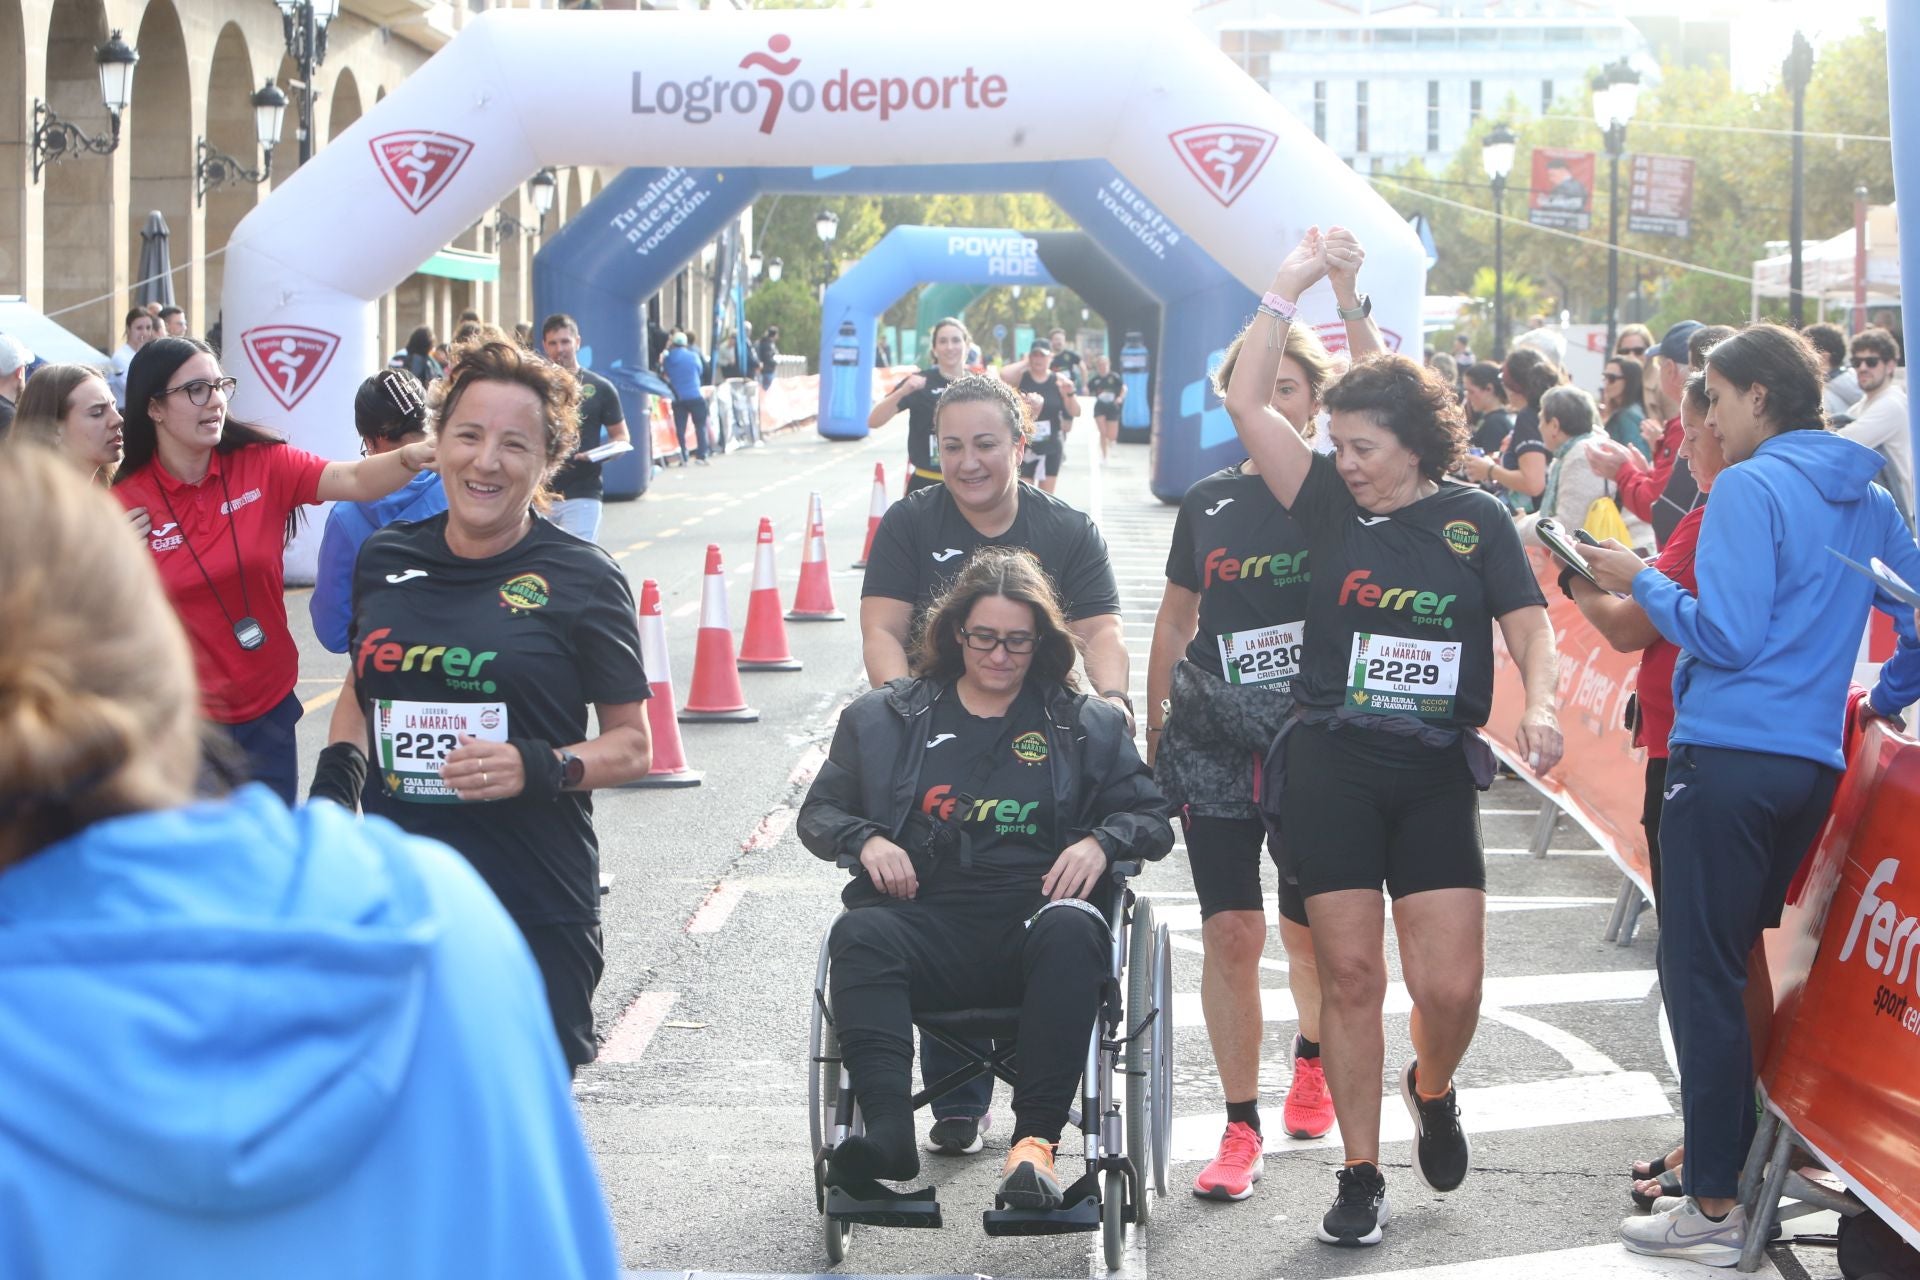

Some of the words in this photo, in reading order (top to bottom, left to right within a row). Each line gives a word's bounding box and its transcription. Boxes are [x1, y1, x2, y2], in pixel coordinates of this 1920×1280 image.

[821, 67, 1009, 121] deporte
[610, 207, 639, 232] Tu
[636, 165, 687, 211] salud,
[626, 176, 697, 244] nuestra
[1109, 178, 1180, 246] nuestra
[636, 190, 711, 256] vocación.
[1097, 187, 1165, 260] vocación.
[948, 236, 1038, 256] POWER
[988, 256, 1038, 276] ADE
[1245, 640, 1256, 651] LA
[1257, 632, 1294, 649] MARATÓN
[356, 627, 498, 680] ferrer
[1239, 644, 1304, 674] 2230
[1380, 645, 1390, 657] LA
[1392, 646, 1432, 662] MARATÓN
[1257, 667, 1294, 679] CRISTINA
[1367, 658, 1439, 685] 2229
[1393, 683, 1411, 692] LOLI
[1371, 694, 1390, 702] CAJA
[1391, 696, 1416, 705] RURAL
[1371, 700, 1382, 708] DE
[1383, 702, 1418, 711] NAVARRA
[405, 714, 417, 729] LA
[420, 713, 467, 730] MARATÓN
[395, 732, 477, 760] 223
[403, 777, 424, 786] CAJA
[424, 778, 445, 787] RUR
[403, 786, 416, 794] DE
[995, 824, 1026, 836] sport
[1838, 857, 1920, 998] ferr
